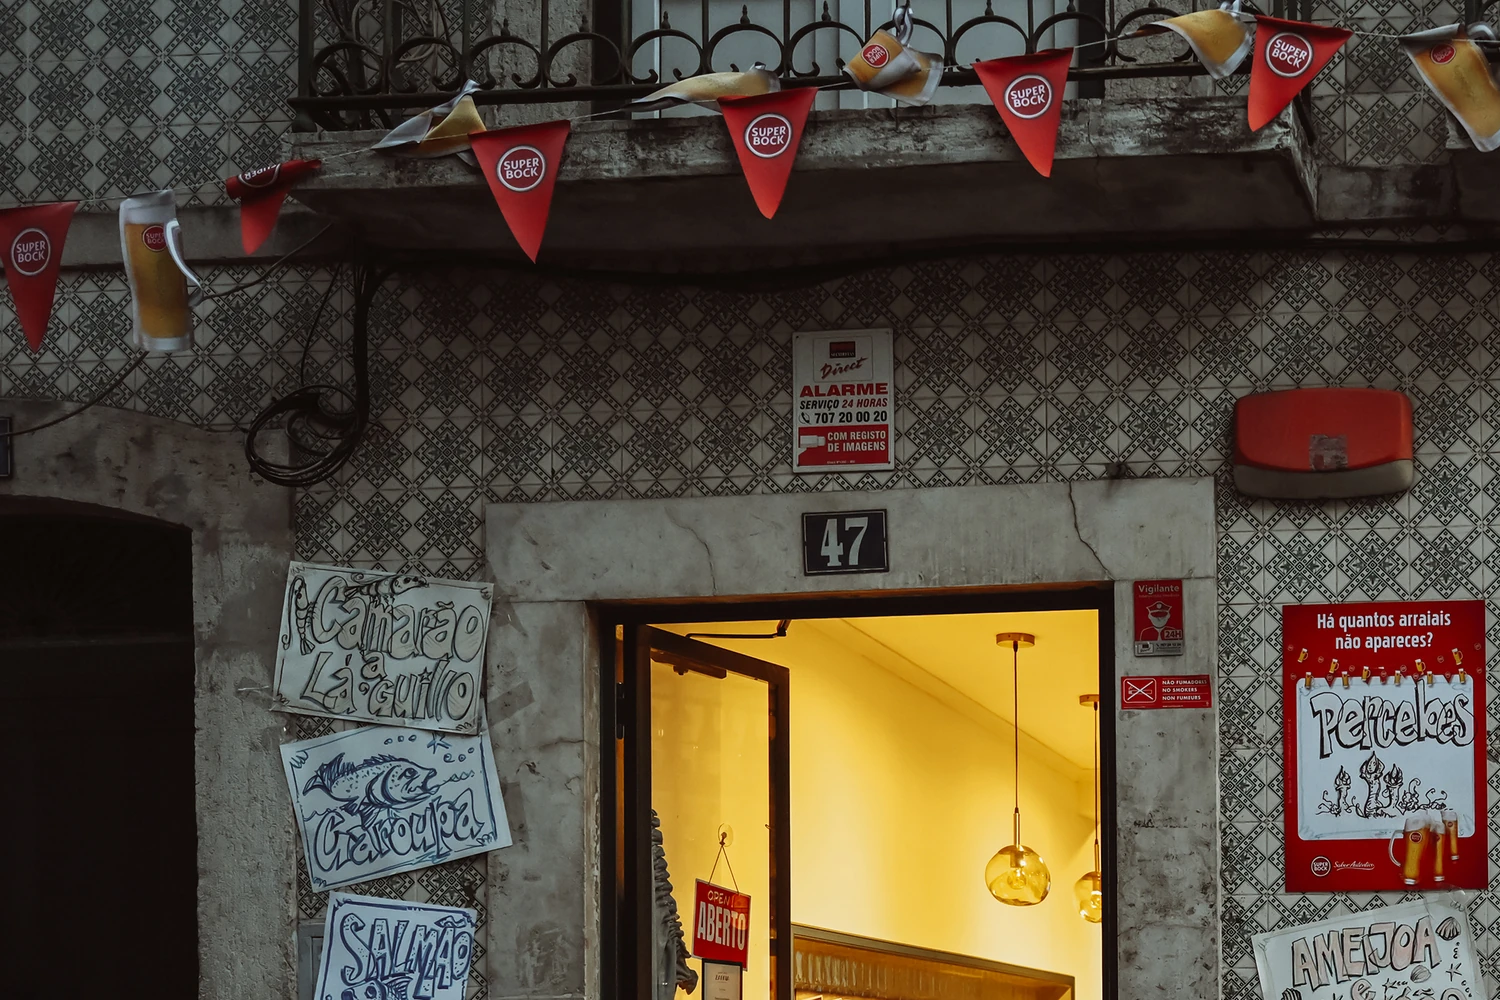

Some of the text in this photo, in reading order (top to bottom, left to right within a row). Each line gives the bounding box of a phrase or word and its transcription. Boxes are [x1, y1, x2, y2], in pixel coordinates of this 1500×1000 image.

[1273, 39, 1307, 60] SUPER
[1271, 48, 1302, 68] BOCK
[1010, 84, 1046, 100] SUPER
[1013, 94, 1045, 108] BOCK
[751, 126, 786, 137] SUPER
[752, 135, 784, 146] BOCK
[503, 157, 539, 170] SUPER
[505, 166, 538, 180] BOCK
[15, 240, 46, 253] SUPER
[17, 250, 45, 263] BOCK
[820, 356, 868, 379] Direct
[800, 383, 888, 397] ALARME
[800, 398, 888, 411] SERVIÇO 24 HORAS
[814, 411, 887, 424] 707 20 00 20
[827, 430, 886, 440] COM REGISTO
[827, 441, 886, 452] DE IMAGENS
[821, 516, 868, 567] 47
[1138, 585, 1180, 595] Vigilante
[311, 576, 484, 662] Camarão
[1317, 611, 1451, 634] Há quantos arraiais
[1165, 630, 1182, 639] 24H
[1335, 632, 1433, 652] não apareces?
[1310, 679, 1479, 758] Percebes
[314, 788, 485, 872] Garoupa
[697, 901, 746, 950] ABERTO
[340, 913, 473, 1000] SALMÃO
[1292, 916, 1443, 991] AMEIJOA
